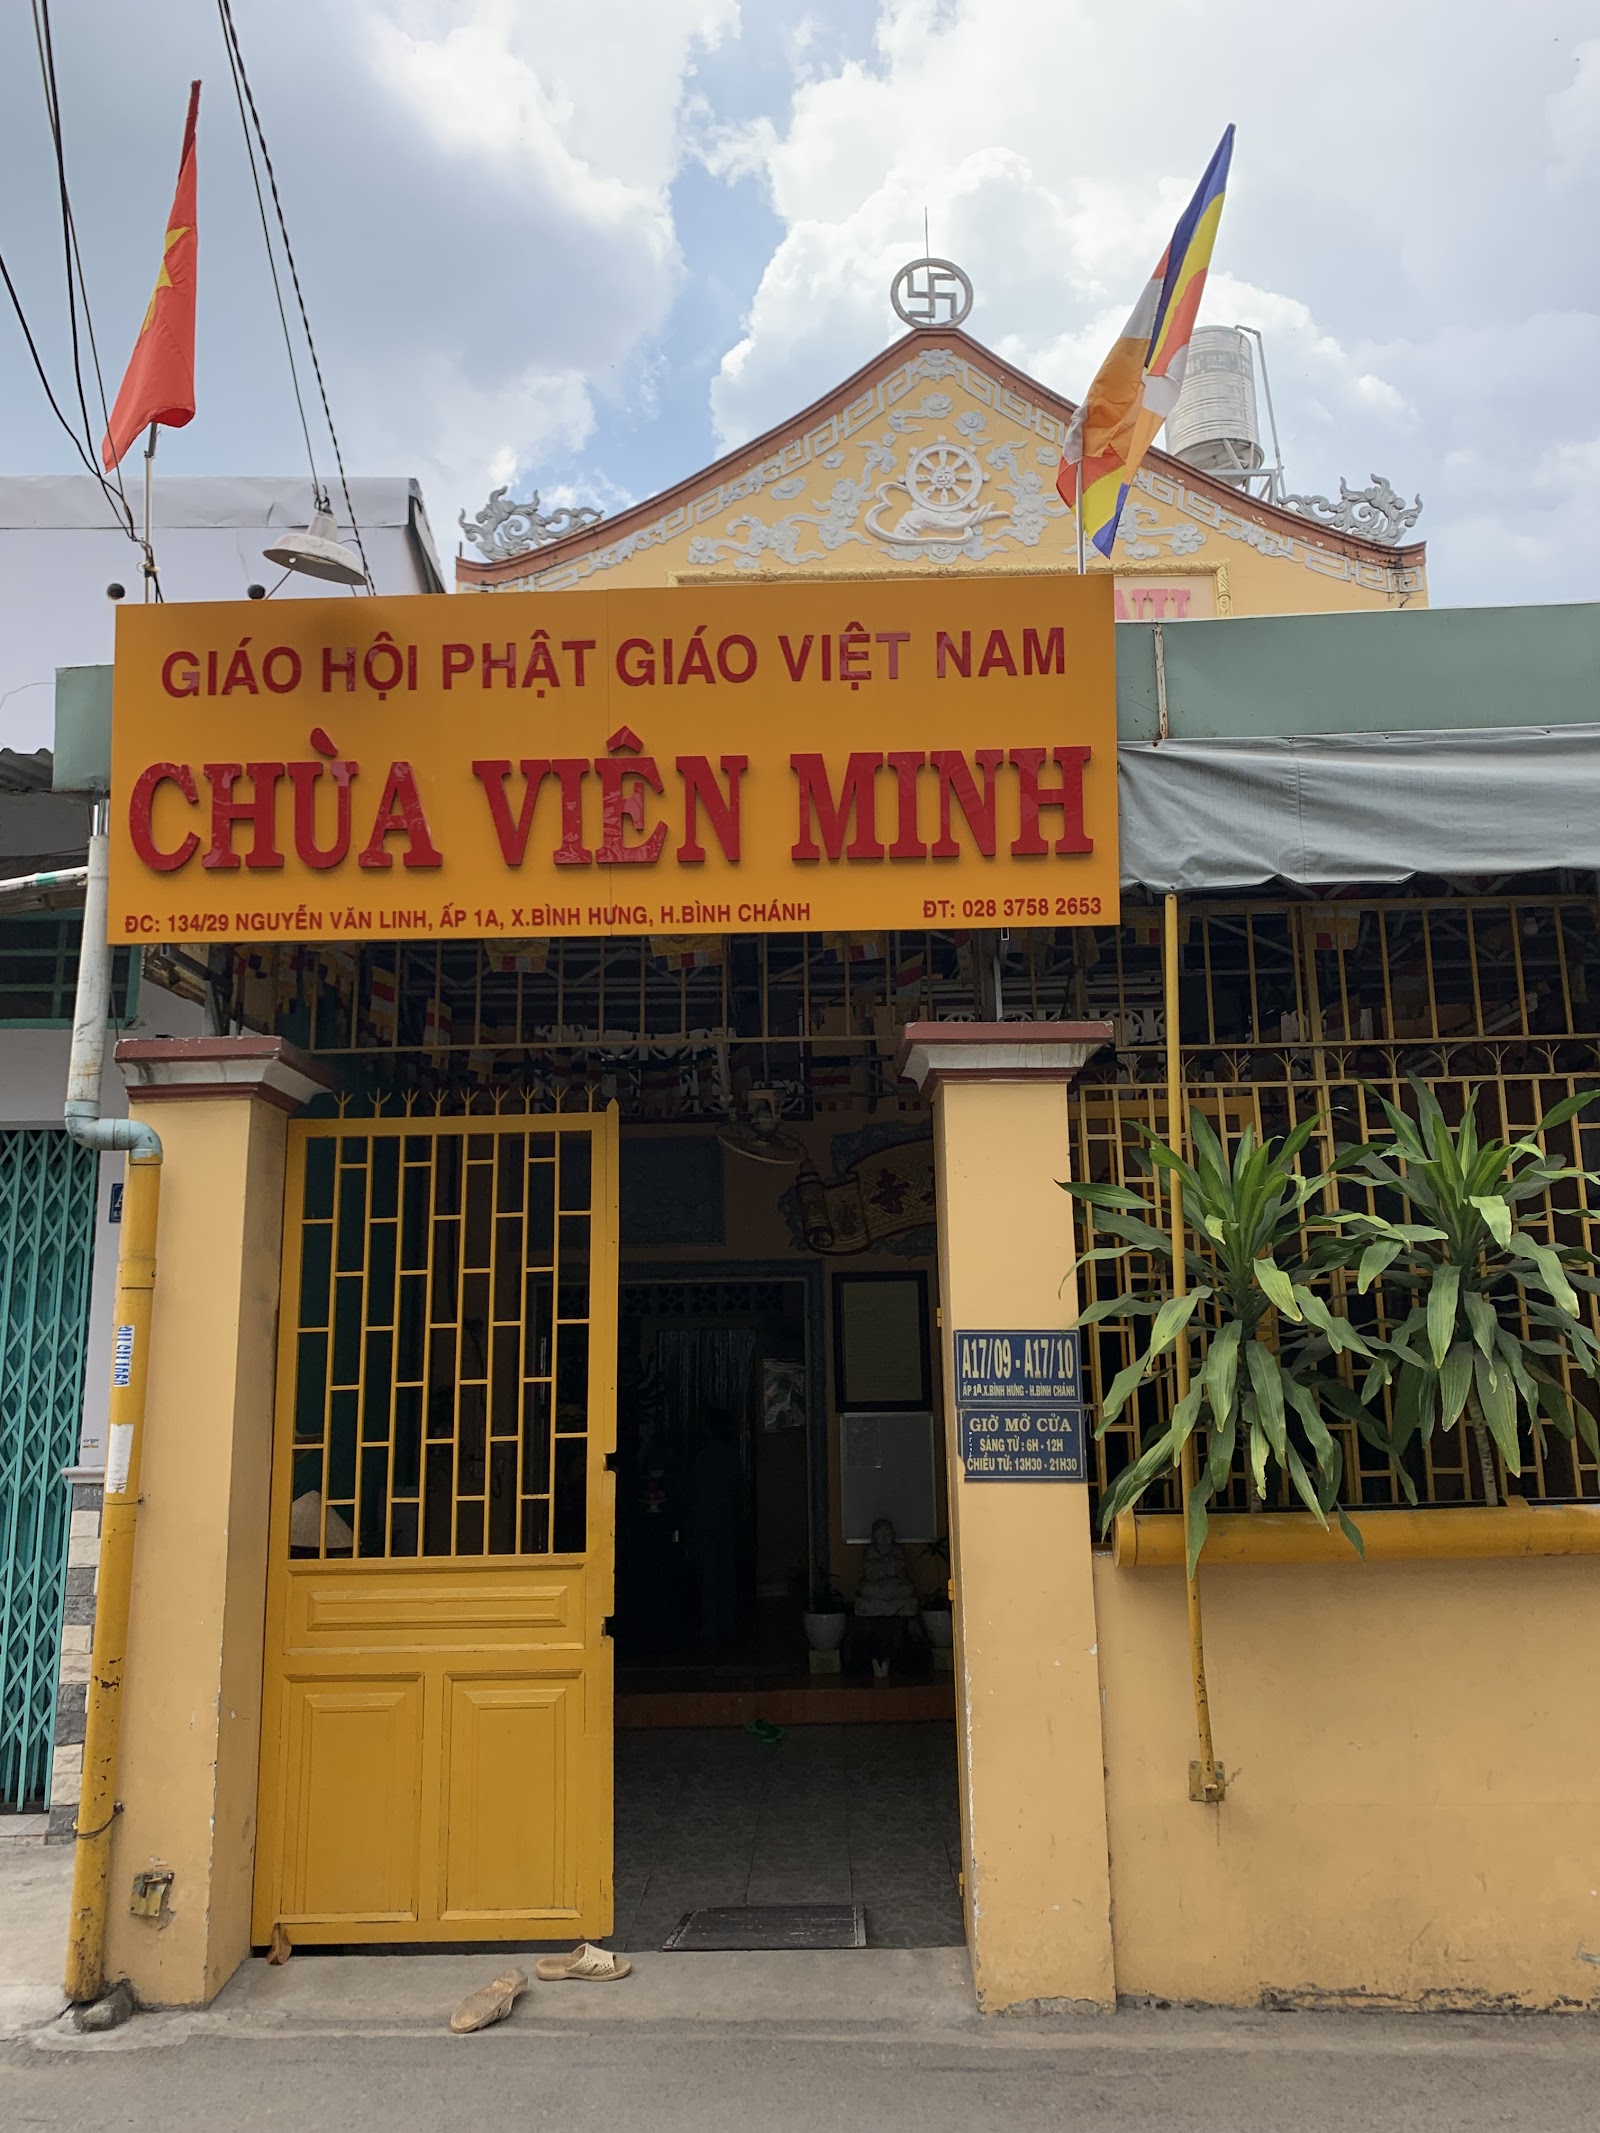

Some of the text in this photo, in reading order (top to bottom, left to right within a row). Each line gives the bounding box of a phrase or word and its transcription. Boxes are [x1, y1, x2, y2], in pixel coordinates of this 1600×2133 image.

[162, 621, 1066, 700] GIÁO HỘI PHẬT GIÁO VIỆT NAM
[129, 725, 1094, 872] CHÙA VIÊN MINH
[125, 899, 811, 933] ĐC: 134/29 NGUYỄN VĂN LINH, ẤP 1A, X.BÌNH HƯNG, H.BÌNH CHÁNH
[923, 897, 1101, 918] ĐT: 028 3758 2653
[962, 1338, 1011, 1379] A17/09
[1024, 1338, 1074, 1379] A17/10
[1053, 1382, 1075, 1396] CHÁNH
[969, 1413, 1072, 1432] GIỜ MỞ CỬA
[980, 1435, 1005, 1452] SÁNG
[1026, 1439, 1038, 1452] 6H
[1046, 1439, 1064, 1452] 12H
[1015, 1458, 1042, 1471] 13H30
[1049, 1458, 1077, 1471] 21H30
